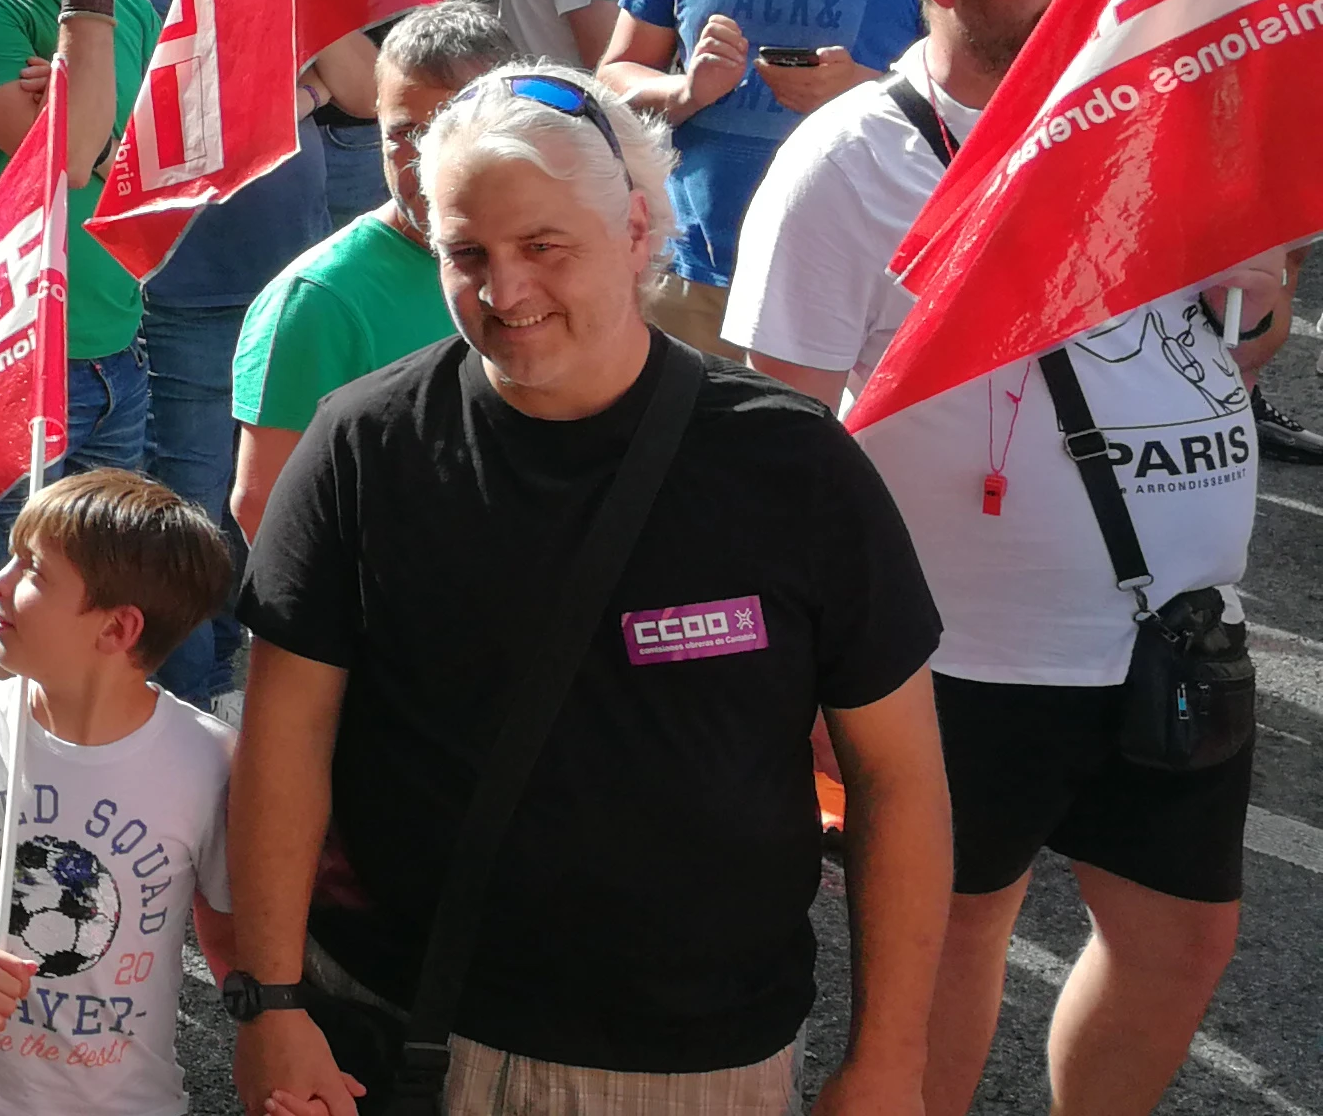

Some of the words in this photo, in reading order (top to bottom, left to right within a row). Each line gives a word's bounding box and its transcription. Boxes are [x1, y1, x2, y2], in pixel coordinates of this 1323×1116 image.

[1107, 425, 1250, 479] PARIS
[1135, 468, 1247, 494] ARRONDISSEMENT
[633, 612, 730, 645] CCOO
[639, 644, 684, 655] comisiones
[685, 638, 714, 650] obreras
[715, 636, 725, 645] de
[84, 798, 172, 936] SQUAD
[115, 951, 155, 986] 20
[19, 1033, 60, 1063] the
